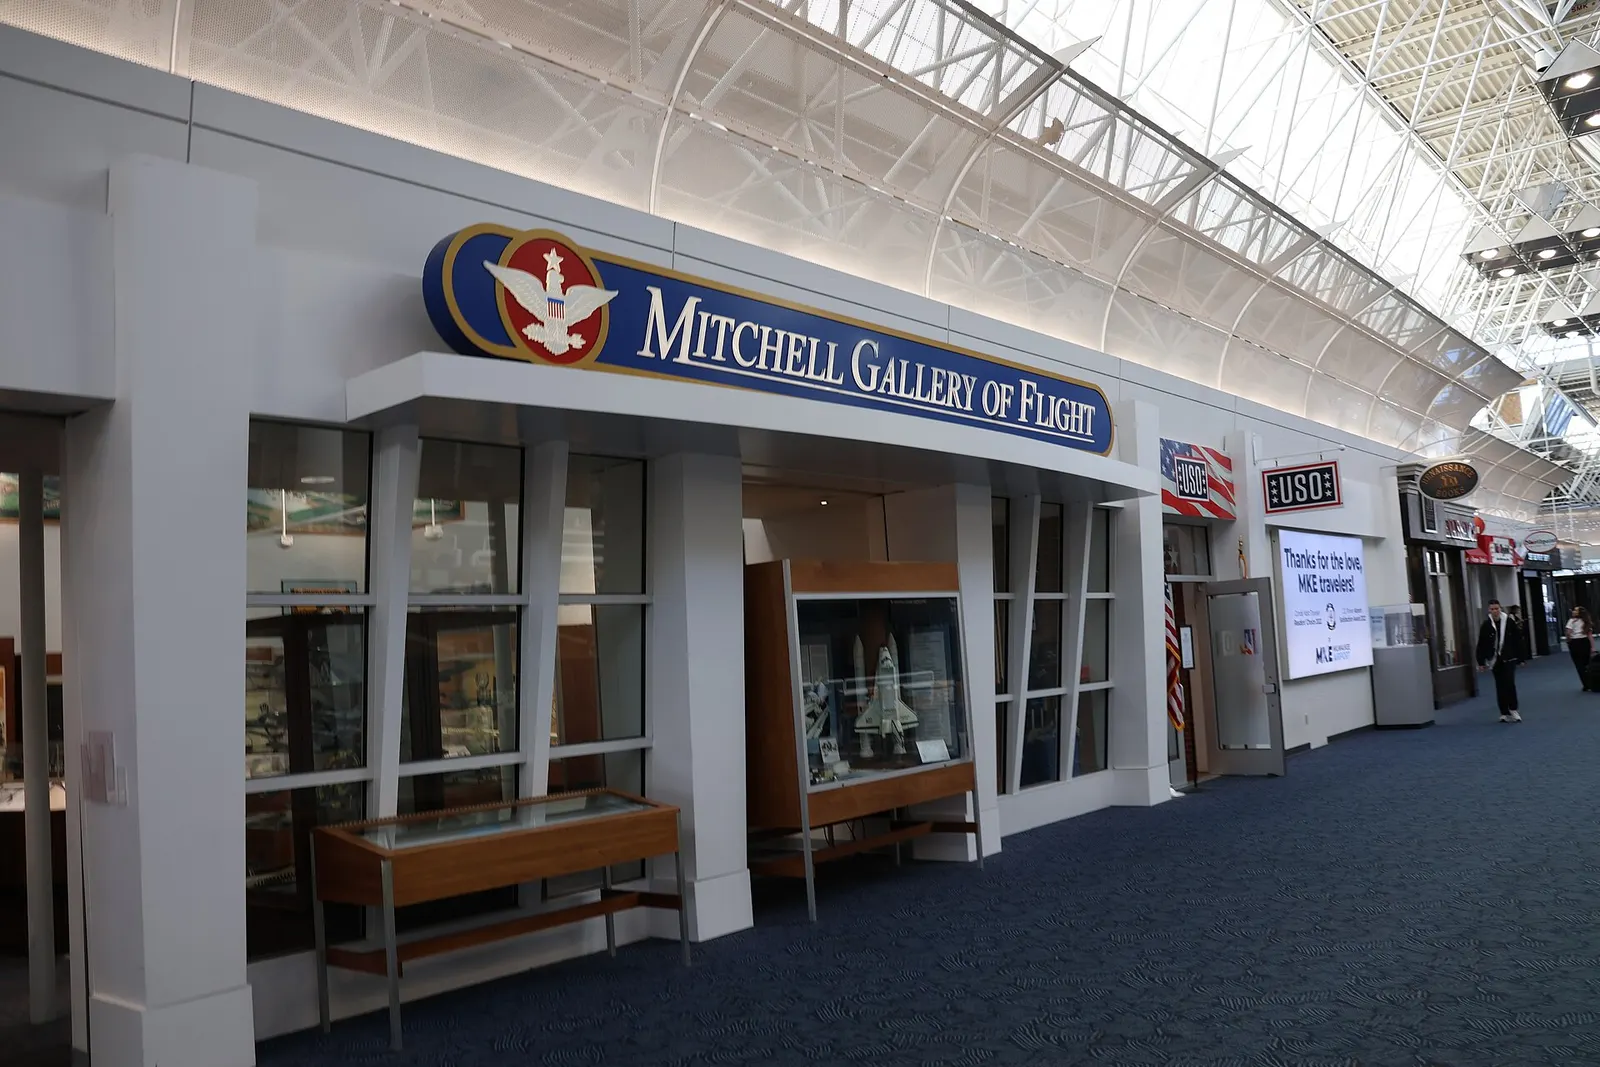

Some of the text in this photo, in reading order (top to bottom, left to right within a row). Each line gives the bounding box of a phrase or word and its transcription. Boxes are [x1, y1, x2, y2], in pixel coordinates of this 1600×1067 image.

[636, 285, 1096, 437] MITCHELL GALLERY OF FLIGHT
[1181, 463, 1203, 495] USO
[1279, 471, 1323, 504] USO
[1284, 547, 1362, 574] Thanks for the love,
[1298, 573, 1355, 593] MKE travelers!
